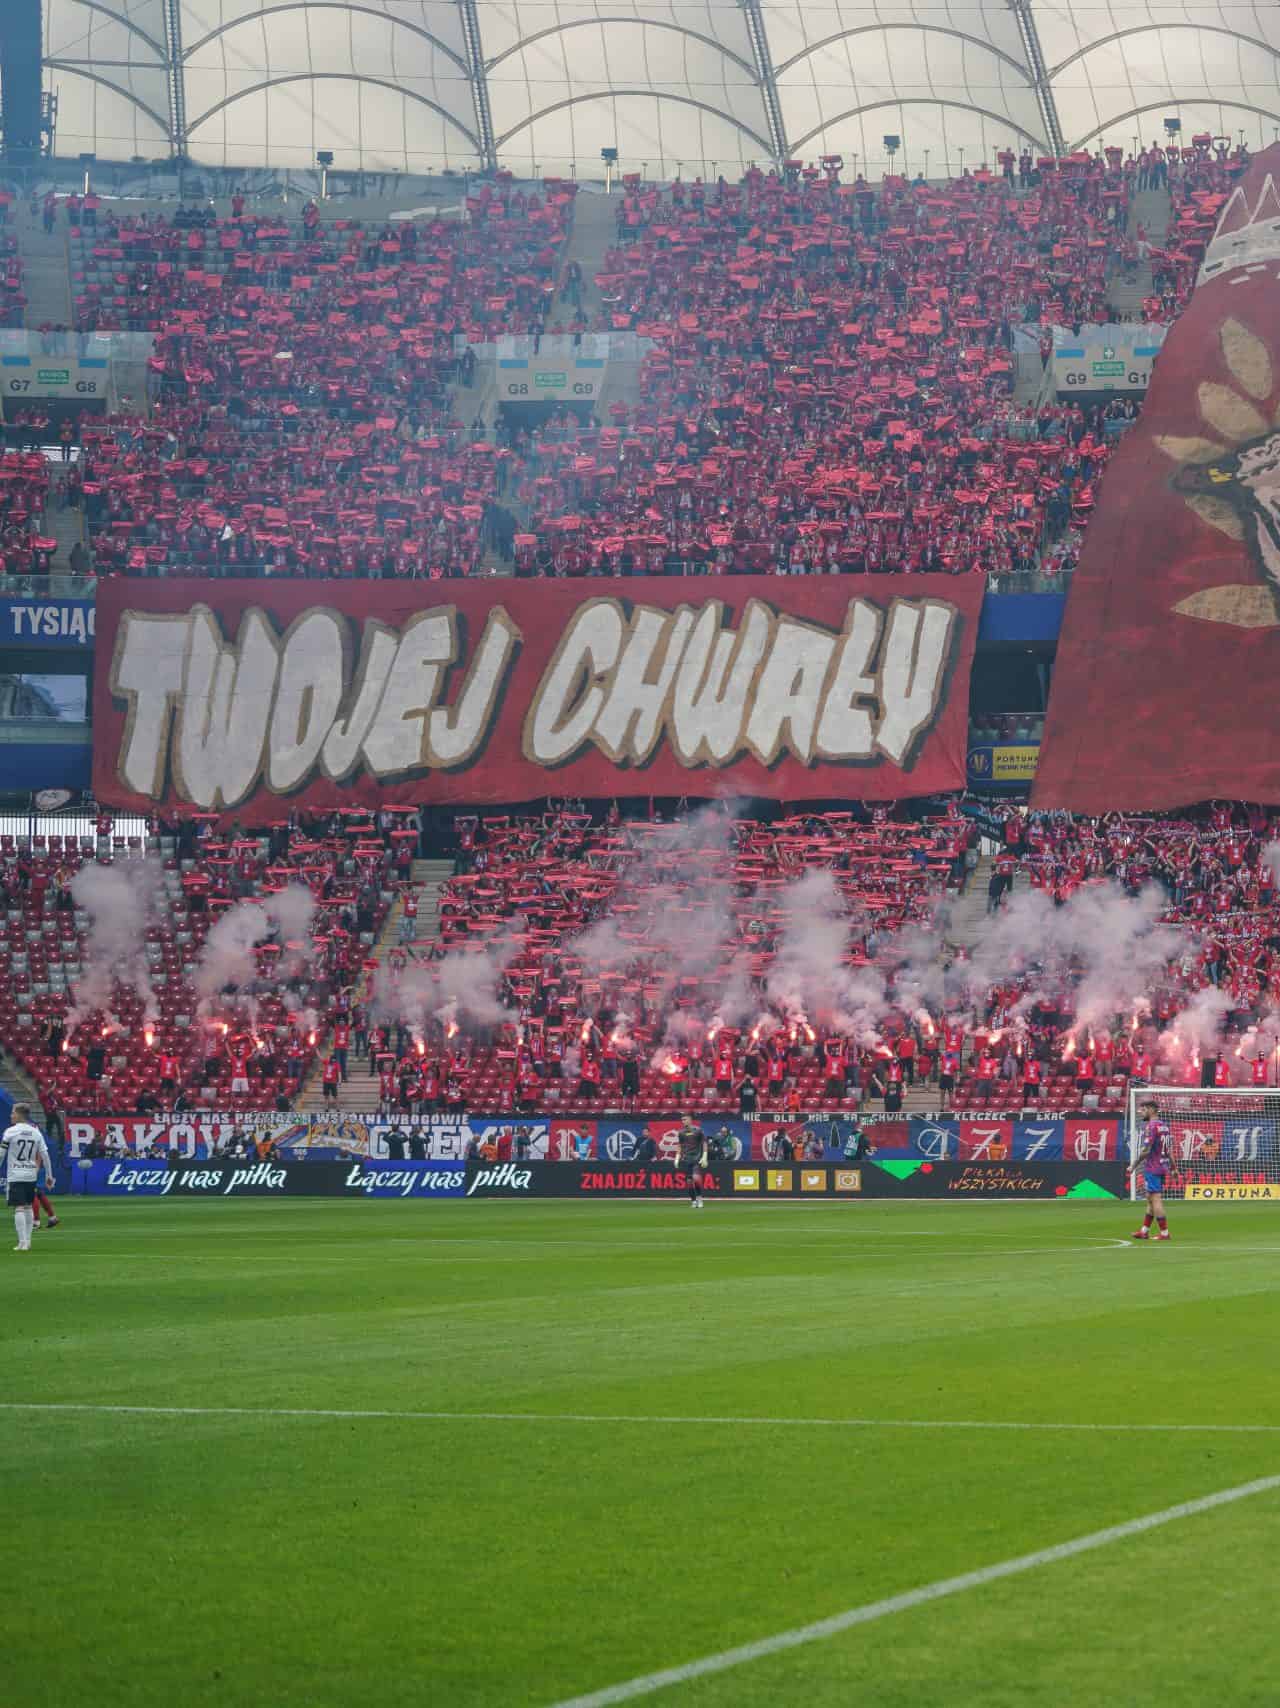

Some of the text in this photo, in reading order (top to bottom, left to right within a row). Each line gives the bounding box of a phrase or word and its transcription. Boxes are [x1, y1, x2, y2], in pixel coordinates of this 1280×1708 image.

[1066, 373, 1087, 385] G9
[1128, 371, 1151, 384] G1
[10, 379, 31, 392] G7
[76, 380, 96, 393] G8
[508, 383, 528, 395] G8
[573, 382, 593, 395] G9
[111, 598, 960, 809] TWOJEJ CHWAŁY
[201, 1113, 229, 1124] NAS
[17, 1139, 35, 1161] 27
[107, 1162, 287, 1195] Łączy nas piłka
[346, 1163, 532, 1197] Łączy nas piłka
[581, 1169, 646, 1189] ZNAJDŹ
[651, 1174, 686, 1189] NAS
[948, 1178, 1044, 1190] WSZYSTKICH
[1193, 1187, 1272, 1198] FORTUNA
